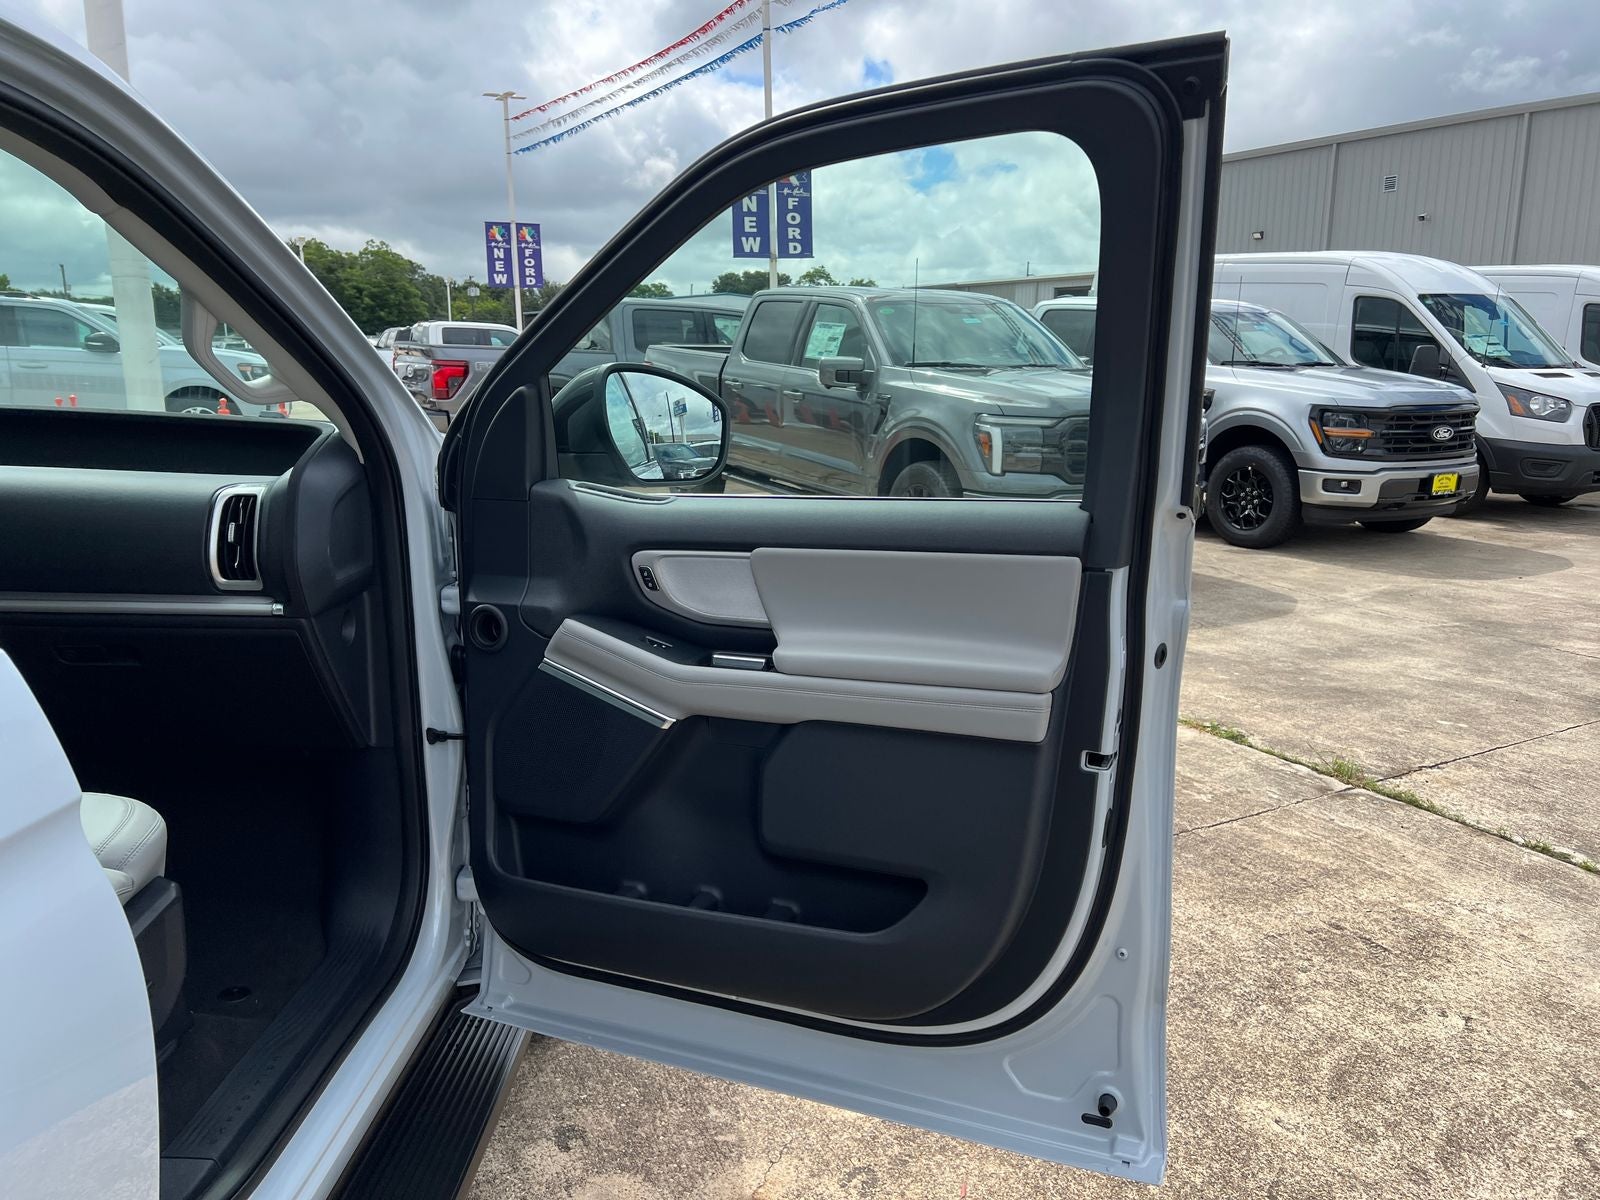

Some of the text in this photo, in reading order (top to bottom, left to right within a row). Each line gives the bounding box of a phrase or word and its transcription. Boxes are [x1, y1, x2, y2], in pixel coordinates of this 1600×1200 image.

[741, 195, 761, 253] NEW
[786, 197, 802, 254] FORD
[493, 247, 507, 285] NEW
[524, 249, 536, 285] FORD
